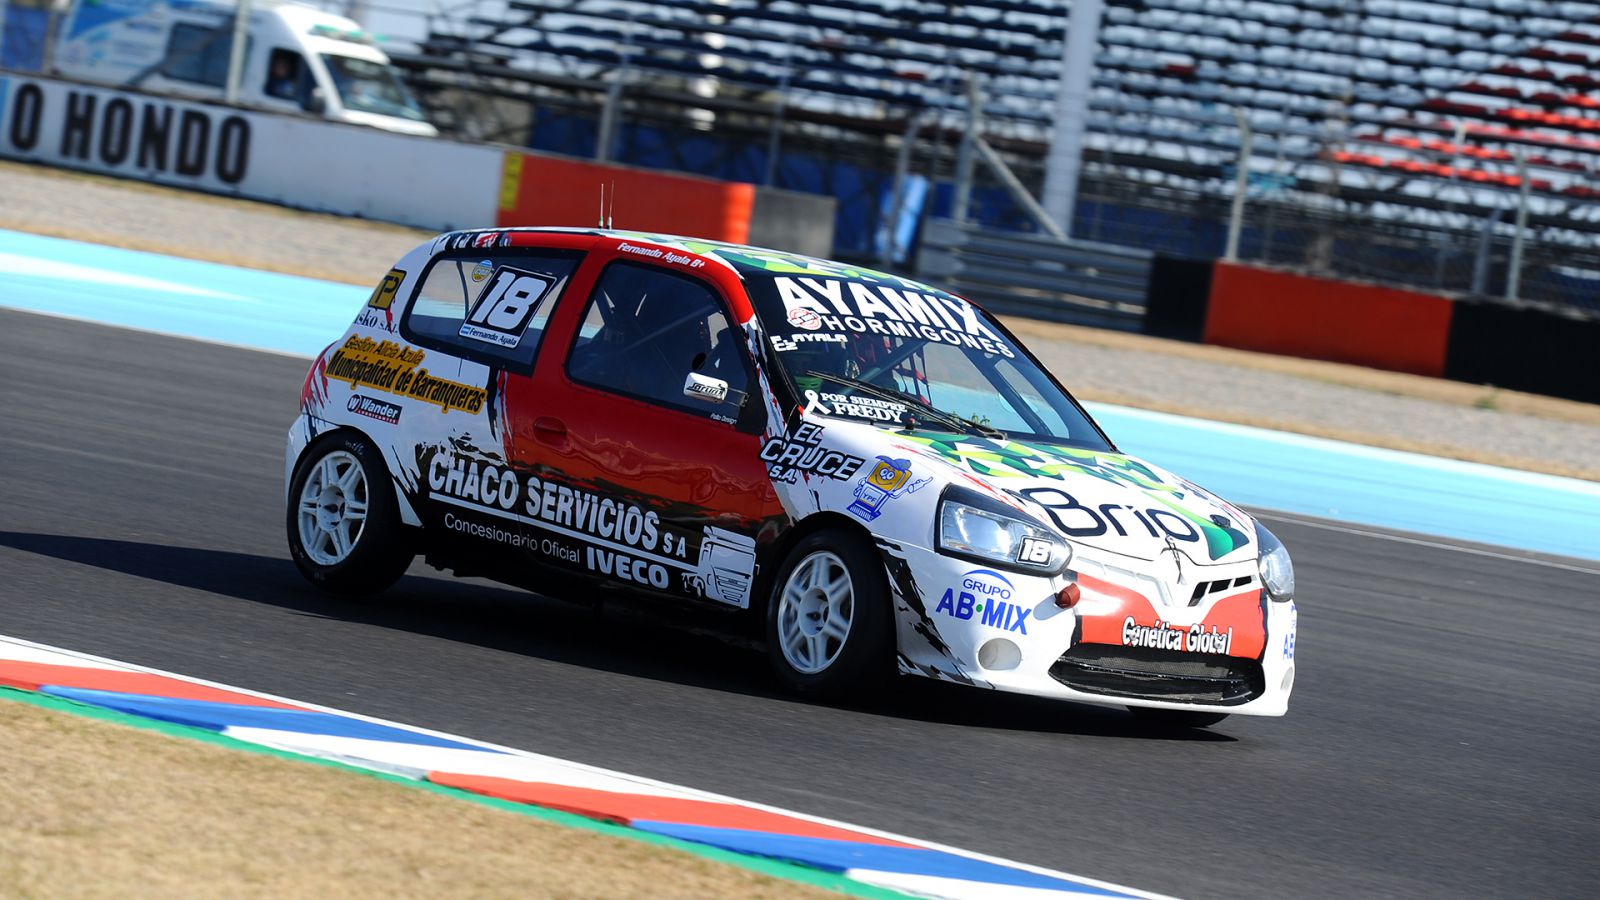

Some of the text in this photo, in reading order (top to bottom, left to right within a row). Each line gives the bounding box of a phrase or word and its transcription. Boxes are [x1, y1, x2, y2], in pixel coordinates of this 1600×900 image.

[9, 82, 252, 184] O HONDO
[617, 242, 663, 258] Fernando
[662, 252, 691, 265] Ayala
[471, 271, 547, 330] 18
[774, 277, 1003, 343] AYAMIX
[469, 327, 518, 347] Fernando Ayala
[820, 315, 1015, 359] HORMIGONES
[326, 350, 486, 412] Municipalidad de Barranqueras
[361, 398, 399, 418] Wander
[820, 393, 907, 412] POR SIEMPRE
[832, 402, 902, 423] FREDY
[793, 423, 824, 445] EL
[760, 438, 865, 481] CRUCE
[769, 466, 798, 484] S.A.
[429, 452, 519, 509] CHACO
[525, 476, 660, 551] SERVICIOS
[863, 492, 877, 502] YPF
[1020, 487, 1200, 543] Brio
[444, 513, 669, 590] Concesionario Oficial IVECO
[1020, 539, 1052, 563] 18
[962, 578, 1011, 600] GRUPO
[1121, 615, 1233, 656] Genética Global
